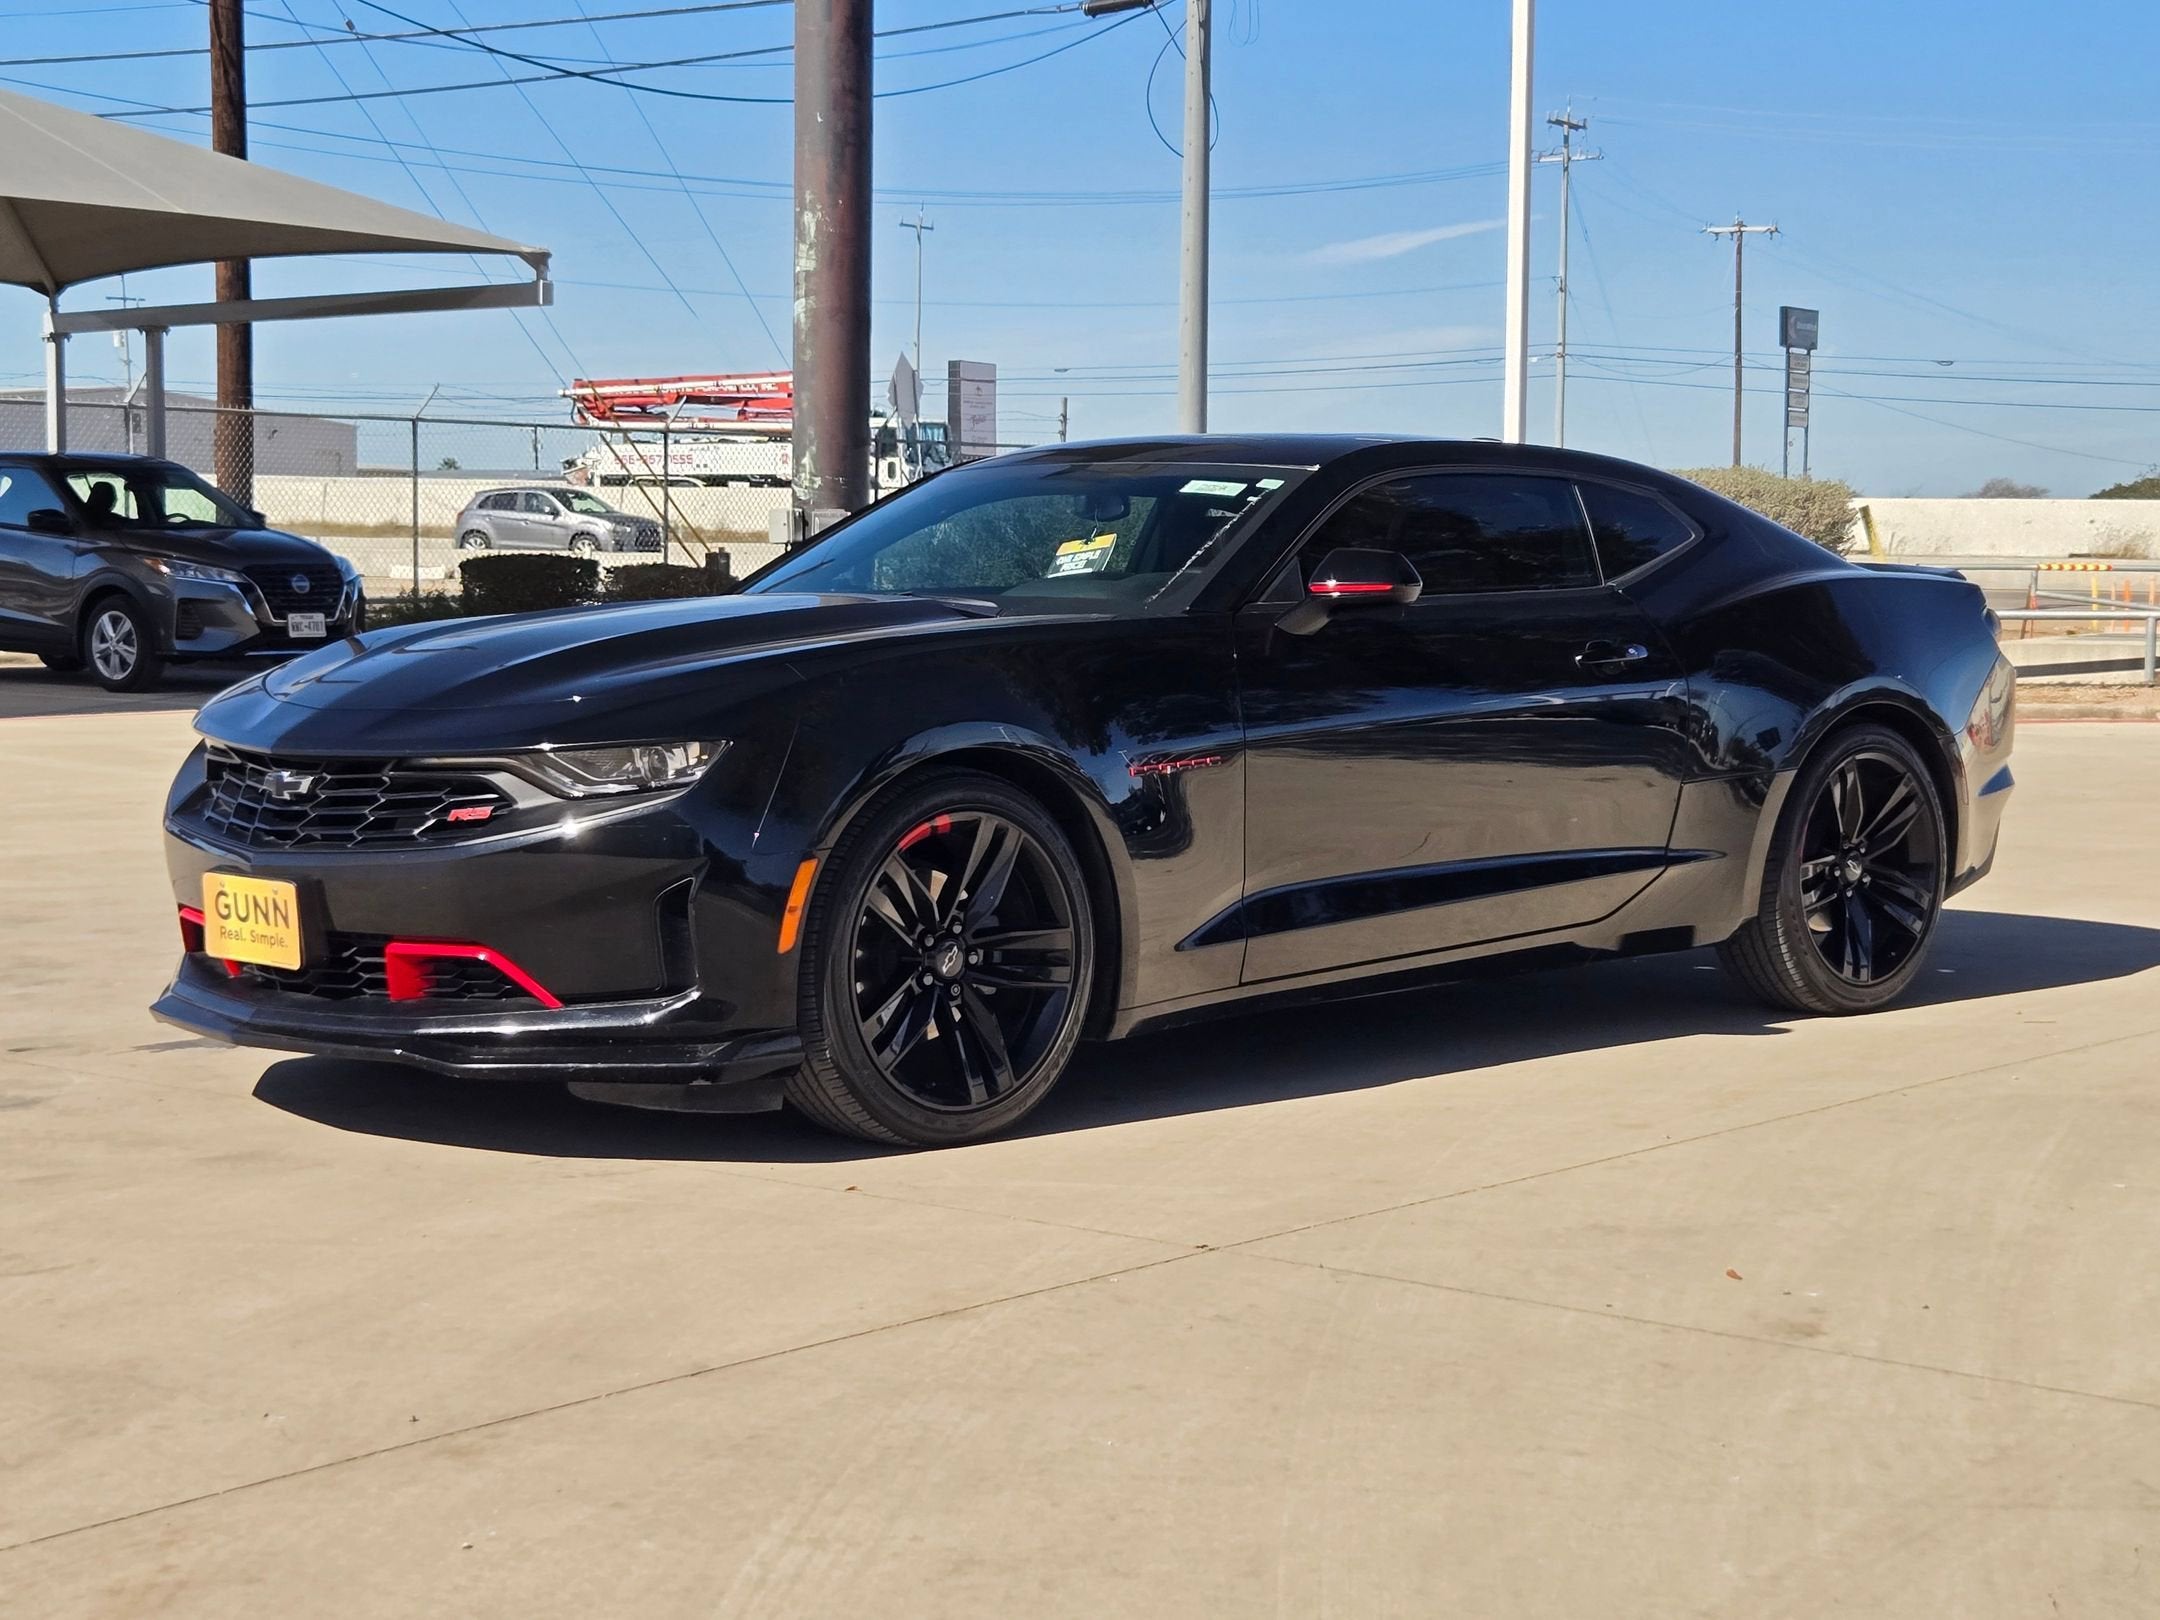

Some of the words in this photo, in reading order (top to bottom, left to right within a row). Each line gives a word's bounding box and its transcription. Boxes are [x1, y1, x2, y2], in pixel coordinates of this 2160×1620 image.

[447, 805, 495, 821] RS
[215, 889, 290, 929] GUNN
[220, 926, 246, 942] Real.
[250, 930, 289, 949] Simple.
